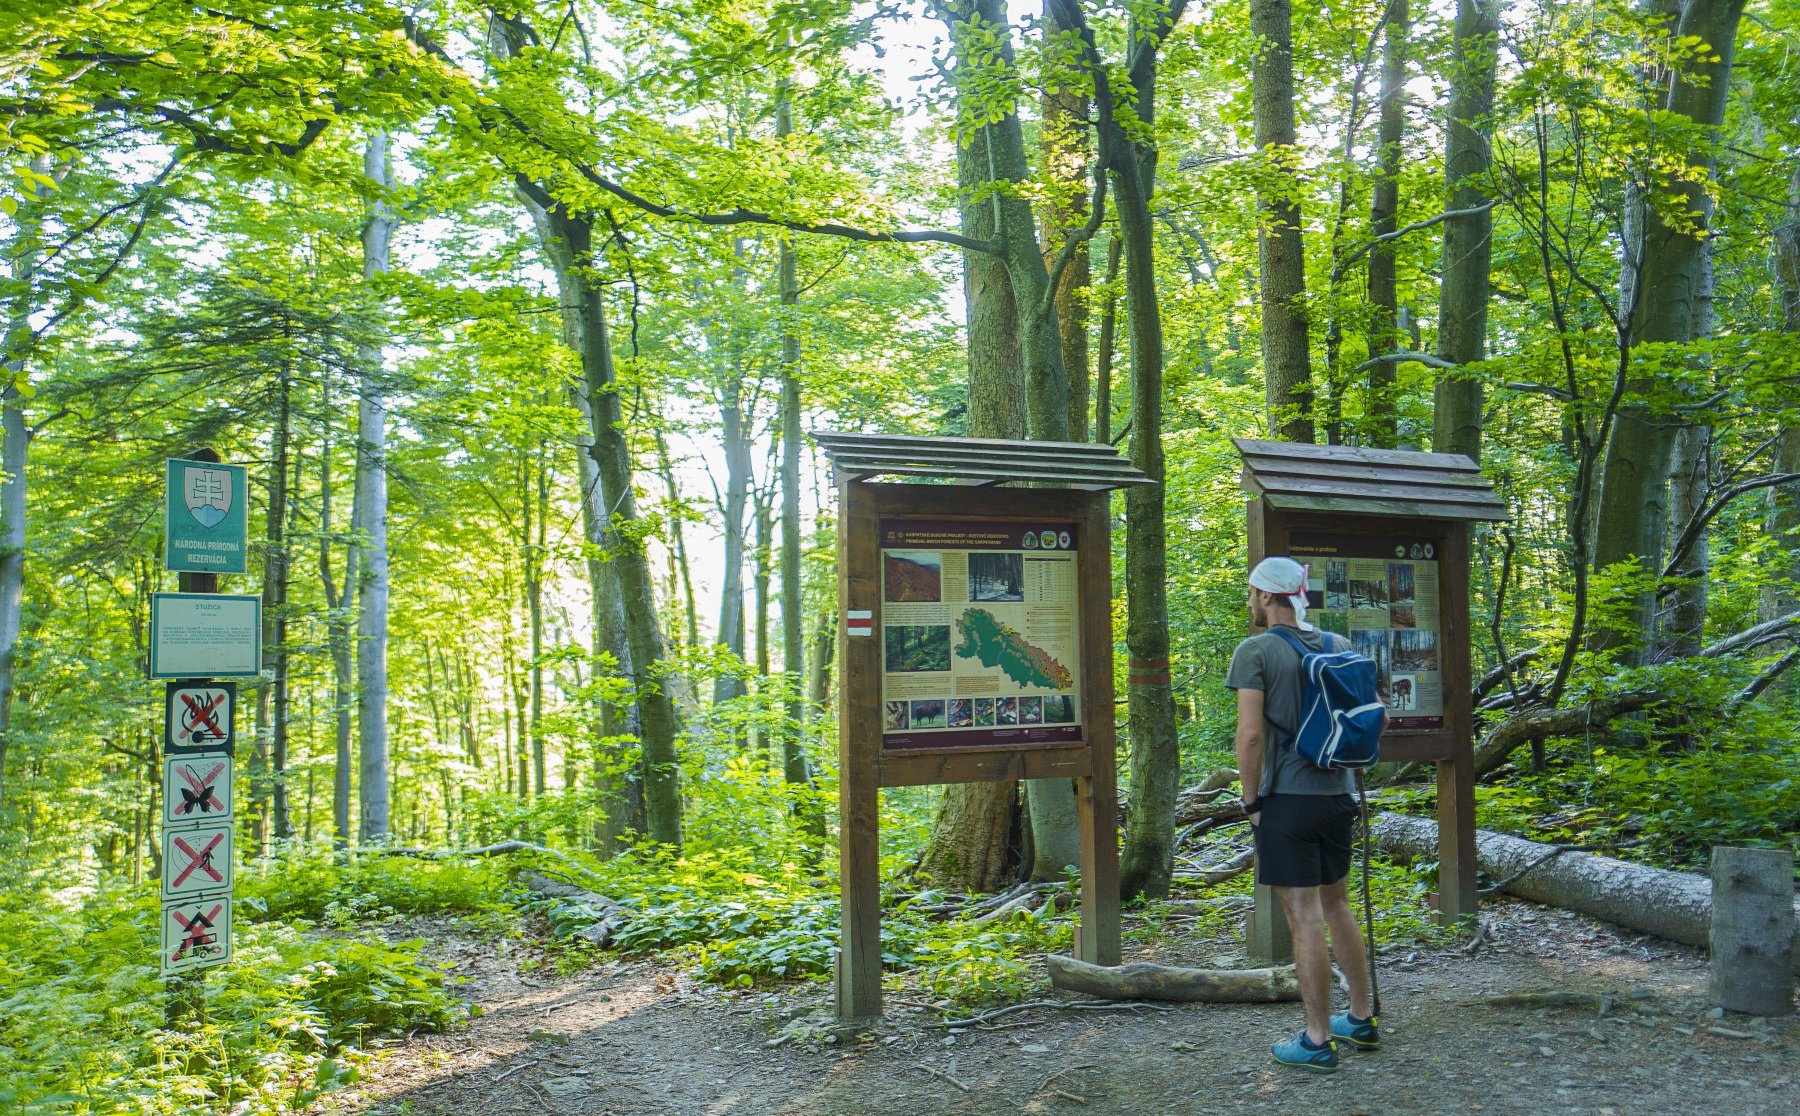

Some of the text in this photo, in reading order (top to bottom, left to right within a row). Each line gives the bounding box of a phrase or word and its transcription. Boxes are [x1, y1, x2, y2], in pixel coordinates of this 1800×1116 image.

[175, 538, 240, 552] NÁRODNÁ PRÍRODNÁ
[187, 553, 227, 564] REZERVÁCIA
